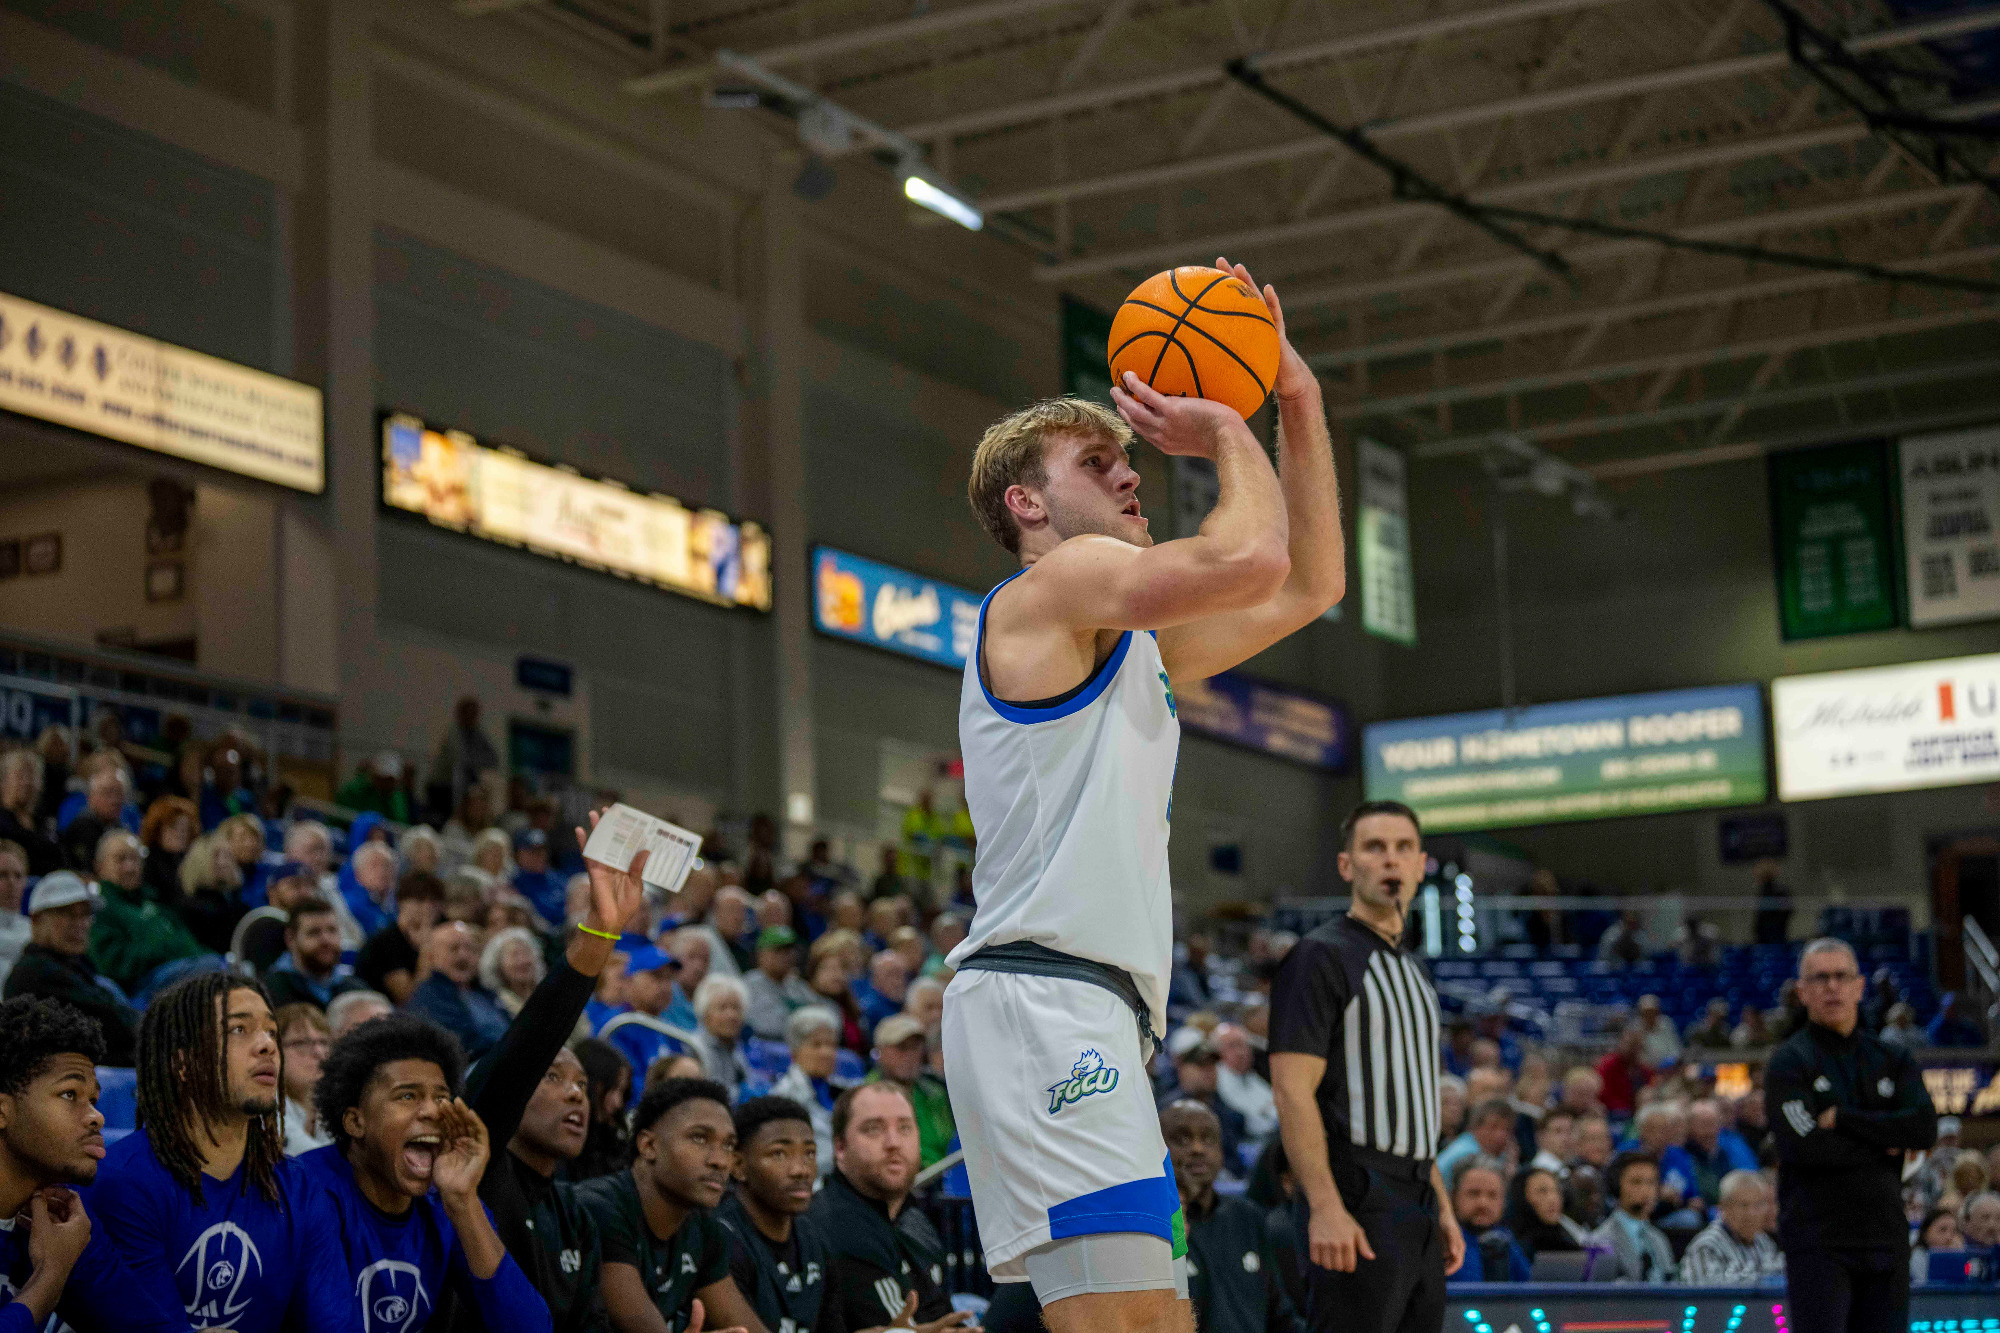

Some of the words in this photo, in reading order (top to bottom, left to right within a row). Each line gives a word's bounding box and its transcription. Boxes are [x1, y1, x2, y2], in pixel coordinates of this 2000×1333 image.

[1381, 736, 1456, 772] YOUR
[1461, 721, 1625, 765] HOMETOWN
[1628, 706, 1744, 747] ROOFER
[1047, 1067, 1119, 1114] FGCU
